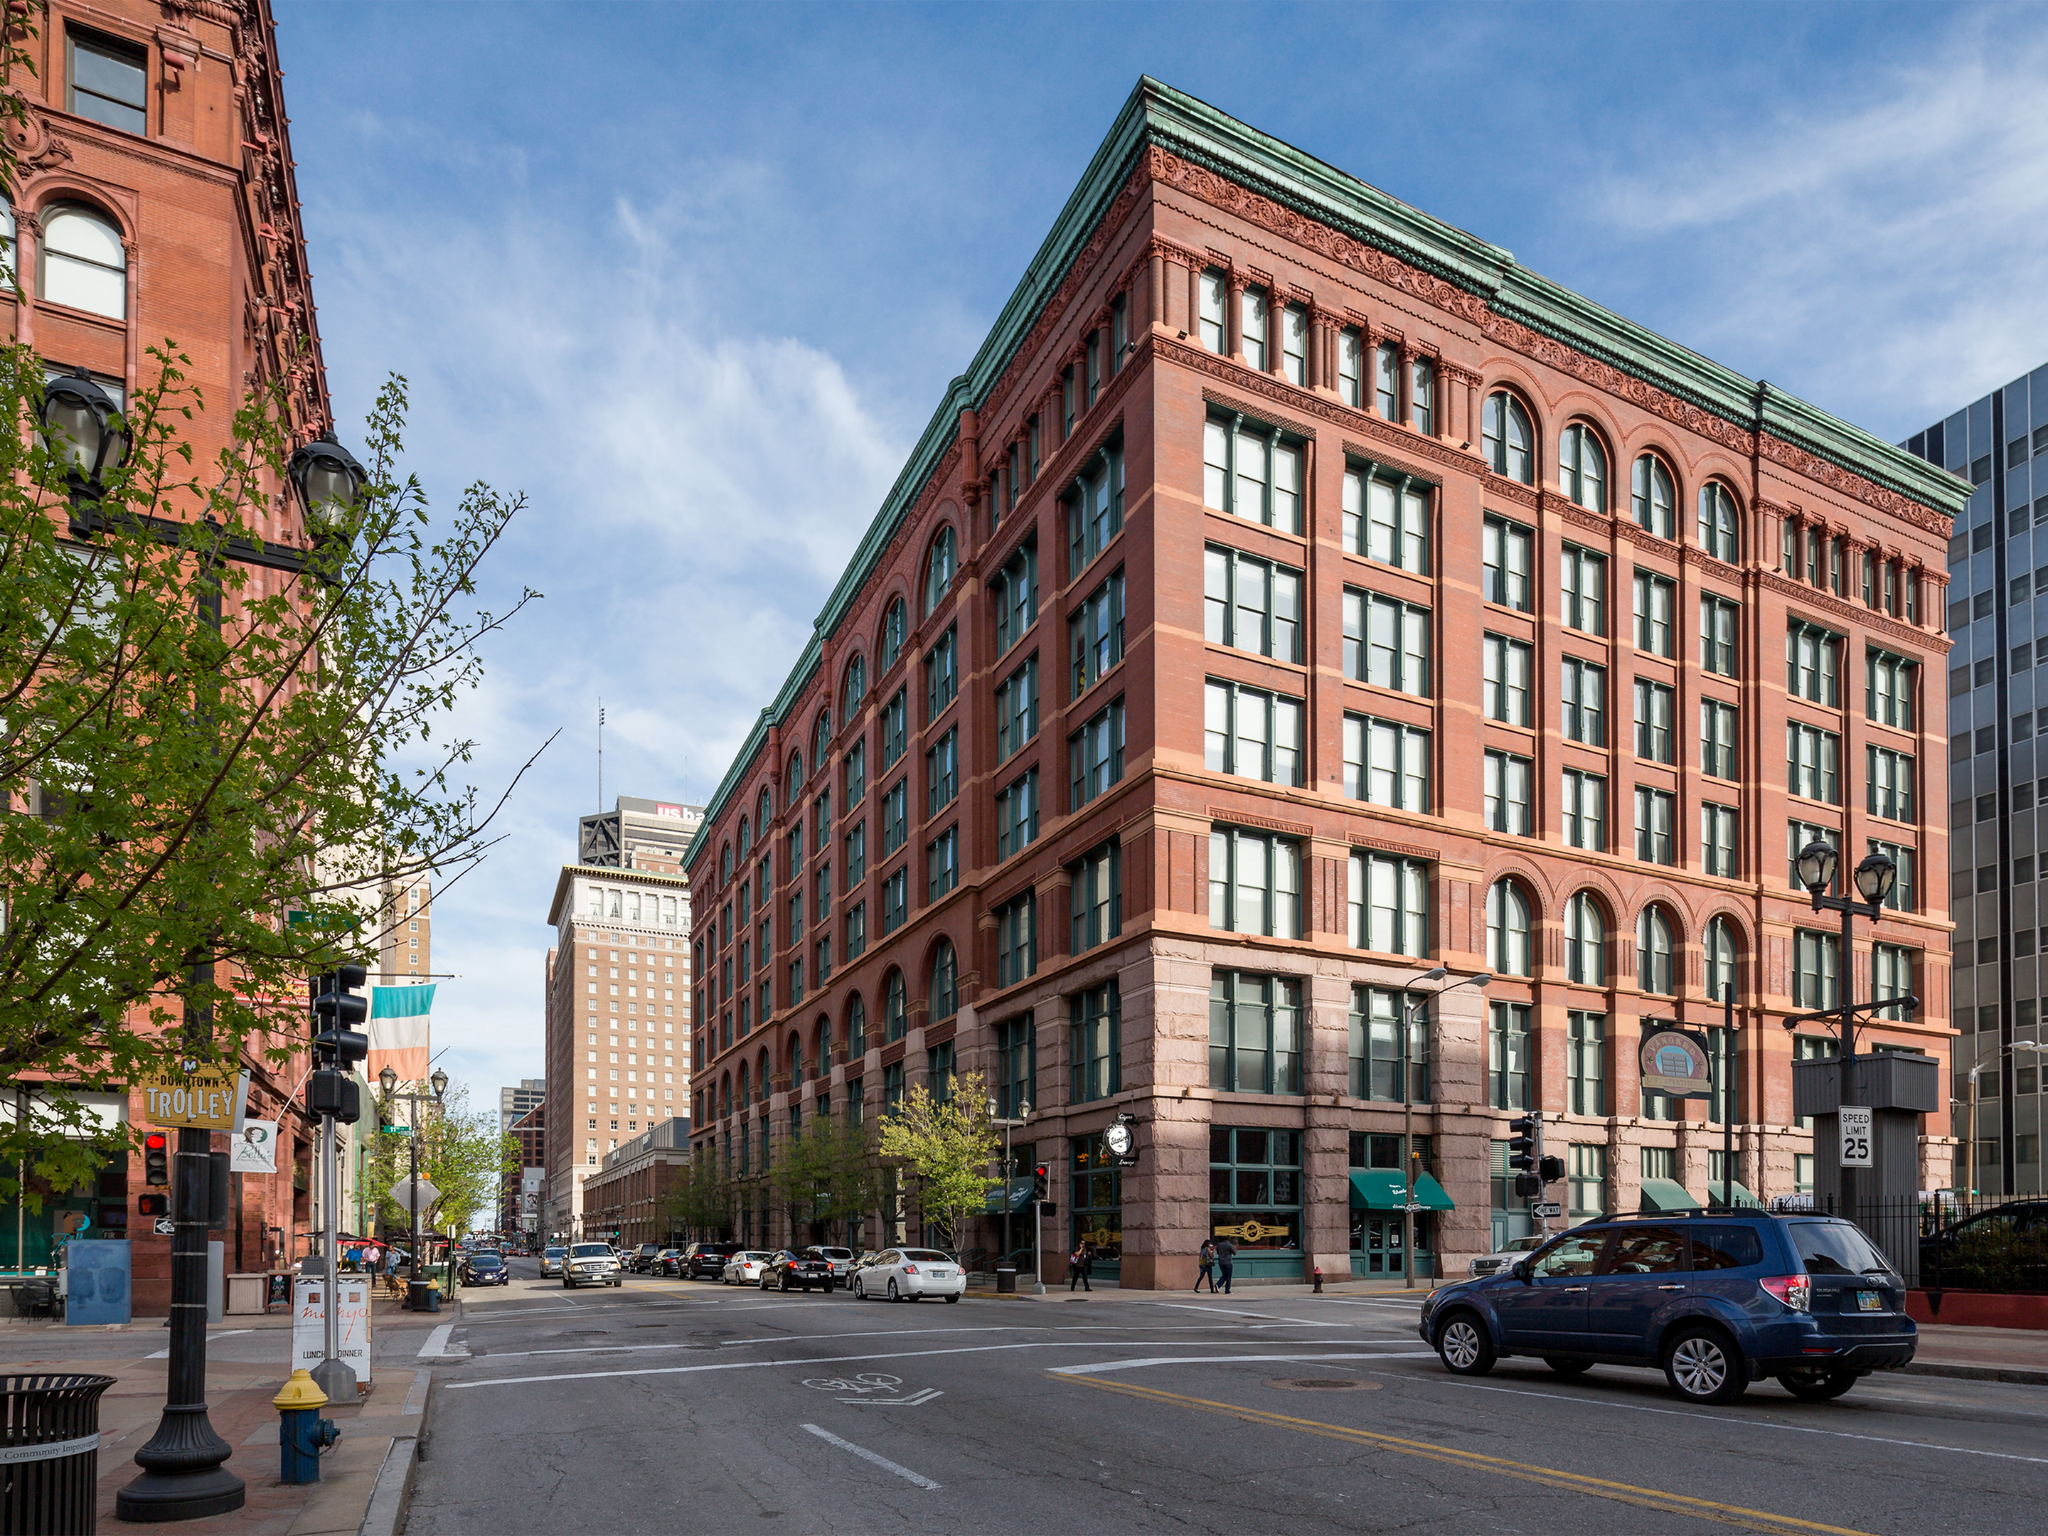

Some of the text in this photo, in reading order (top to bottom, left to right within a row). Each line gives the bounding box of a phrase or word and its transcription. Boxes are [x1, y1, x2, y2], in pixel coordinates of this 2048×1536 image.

[1649, 1036, 1696, 1056] VANGARD
[146, 1087, 234, 1119] TROLLEY
[1842, 1113, 1870, 1123] SPEED
[1845, 1125, 1867, 1135] LIMIT
[1844, 1137, 1869, 1160] 25
[303, 1349, 363, 1359] LUNCH DINNER
[4, 1446, 60, 1460] Community
